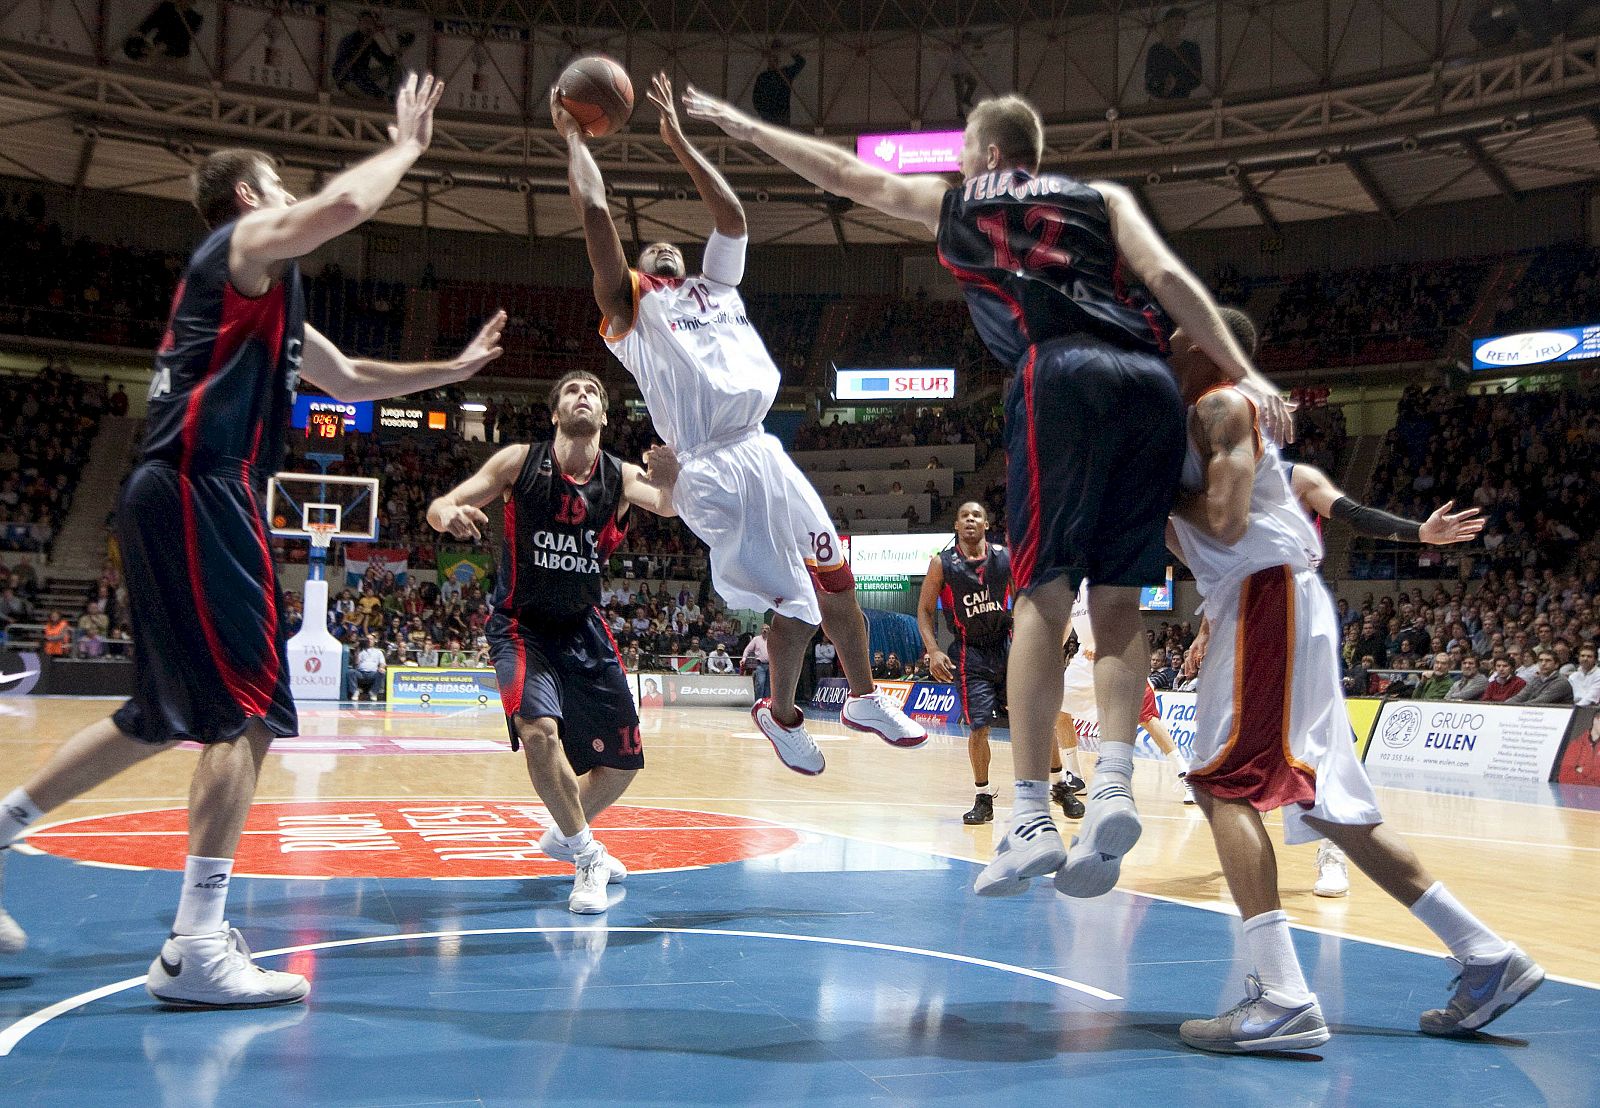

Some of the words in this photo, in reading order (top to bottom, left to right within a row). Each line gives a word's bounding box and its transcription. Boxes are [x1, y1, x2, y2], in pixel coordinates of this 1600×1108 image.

[964, 172, 1061, 201] TELEOVIC
[976, 204, 1071, 271] 12
[1486, 350, 1519, 362] REM
[1535, 343, 1563, 358] IRU
[895, 377, 949, 392] SEUR
[406, 409, 423, 418] con
[320, 424, 336, 438] 19
[381, 418, 418, 429] nosotros
[555, 493, 588, 526] 19
[533, 530, 578, 553] CAJA
[856, 549, 877, 562] San
[881, 548, 919, 563] Miguel
[398, 683, 434, 693] VIAJES
[435, 683, 479, 693] BIDASOA
[680, 686, 749, 696] BASKONIA
[914, 687, 954, 711] Diario
[1431, 711, 1484, 731] GRUPO
[1424, 733, 1477, 751] EULEN
[278, 813, 400, 853] RIOJA
